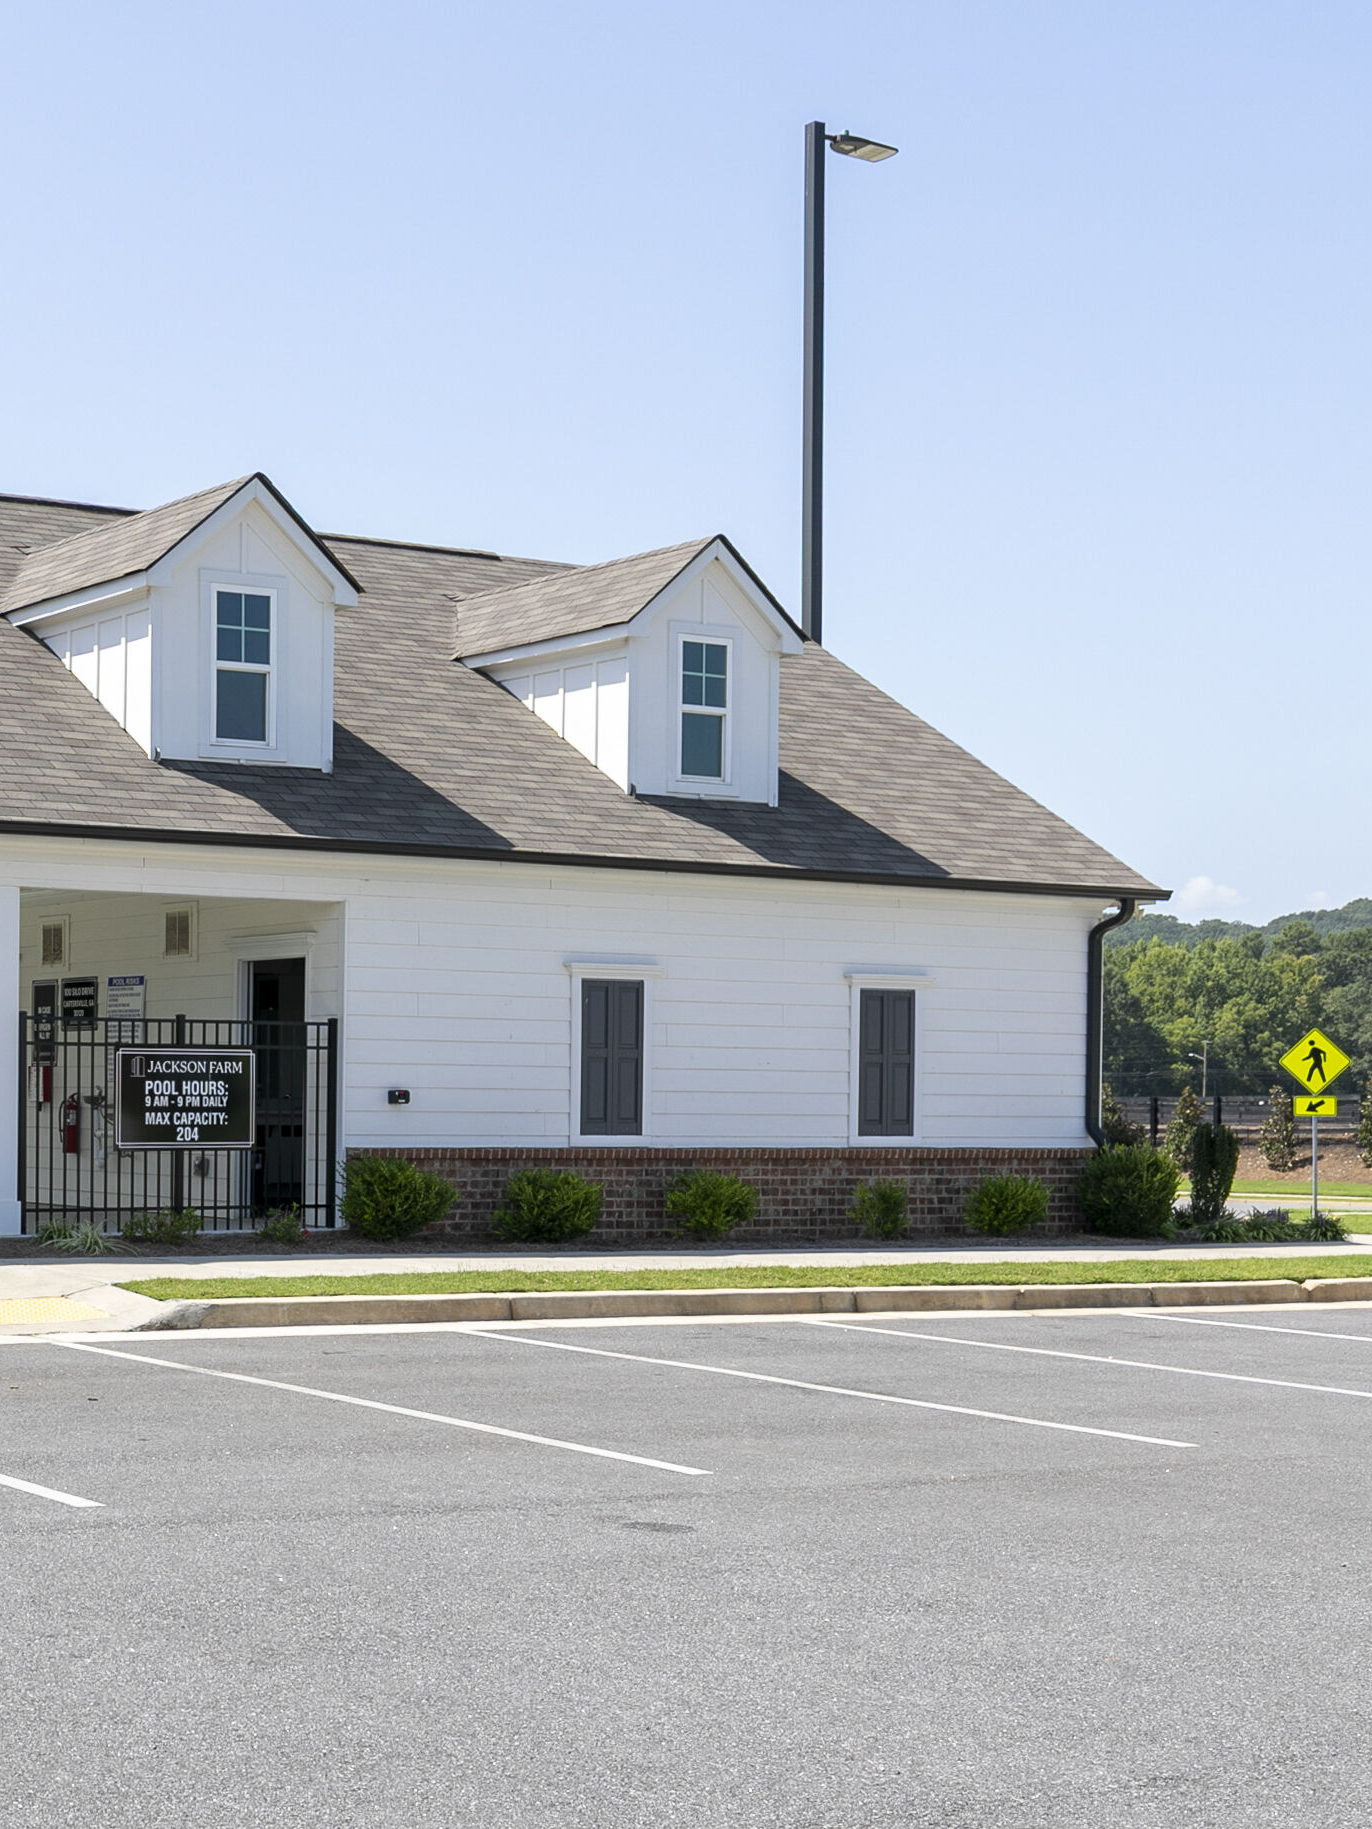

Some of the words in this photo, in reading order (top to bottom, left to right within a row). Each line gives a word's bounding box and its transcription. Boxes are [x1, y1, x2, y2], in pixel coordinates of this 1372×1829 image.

[81, 986, 94, 996] DRIVE
[147, 1060, 207, 1074] JACKSON
[209, 1061, 243, 1074] FARM
[145, 1080, 179, 1095] POOL
[182, 1080, 229, 1096] HOURS:
[145, 1096, 151, 1107] 9
[153, 1096, 169, 1107] AM
[177, 1096, 183, 1107] 9
[185, 1096, 200, 1107] PM
[202, 1096, 228, 1107] DAILY
[145, 1112, 170, 1125] MAX
[173, 1112, 228, 1125] CAPACITY:
[176, 1126, 199, 1141] 204
